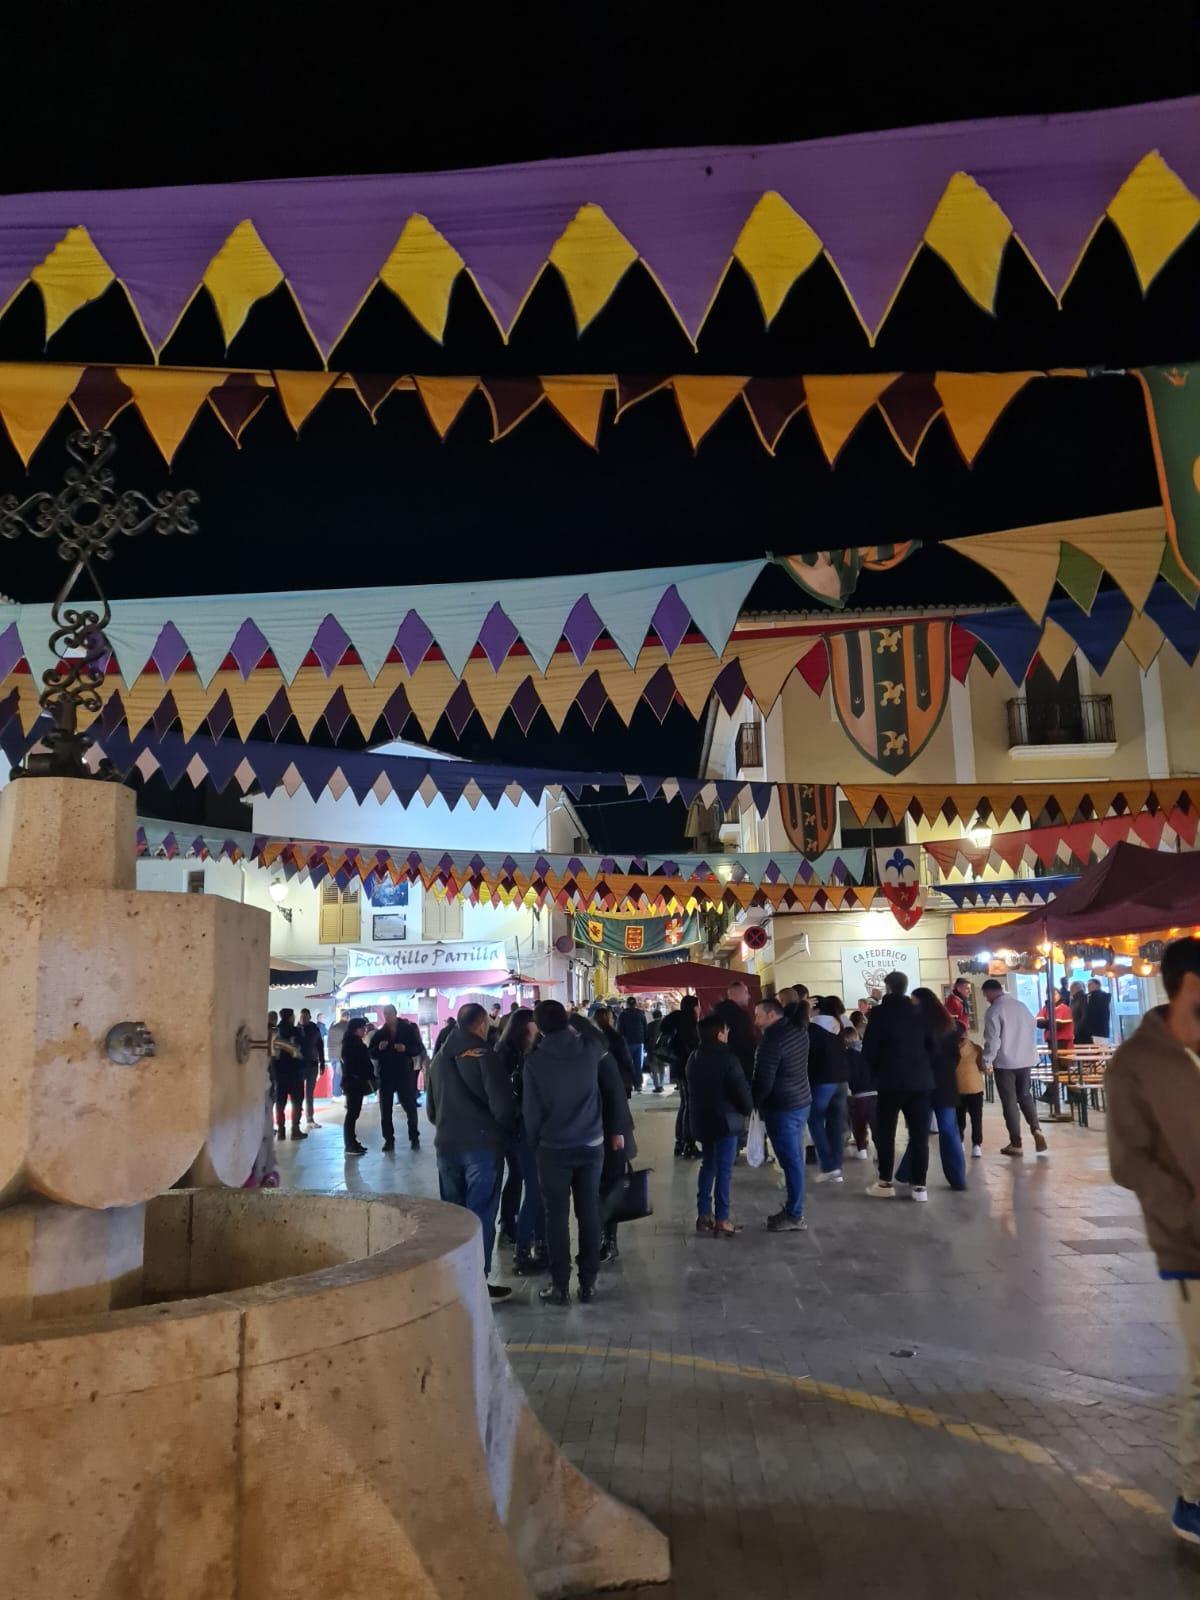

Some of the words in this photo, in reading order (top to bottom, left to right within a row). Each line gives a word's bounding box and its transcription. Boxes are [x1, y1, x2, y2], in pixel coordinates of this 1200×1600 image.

[355, 951, 429, 970] Bocadillo
[433, 947, 499, 966] Parrilla
[853, 953, 865, 963] CA
[865, 949, 907, 961] FEDERICO
